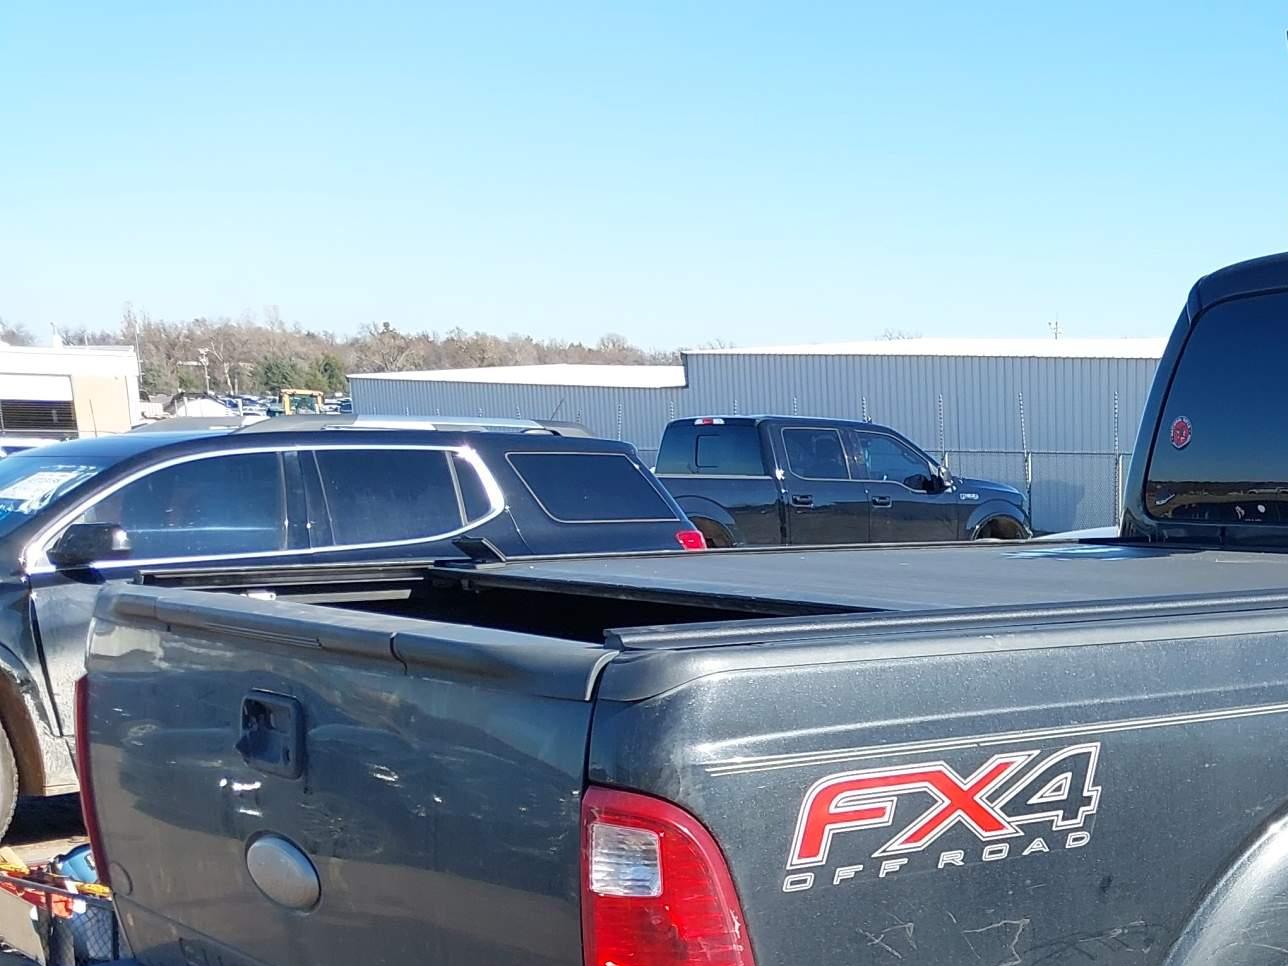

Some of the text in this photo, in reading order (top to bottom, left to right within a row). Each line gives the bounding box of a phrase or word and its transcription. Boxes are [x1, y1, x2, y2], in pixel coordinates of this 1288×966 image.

[785, 741, 1102, 870] FX4
[782, 830, 1092, 893] OFF ROAD
